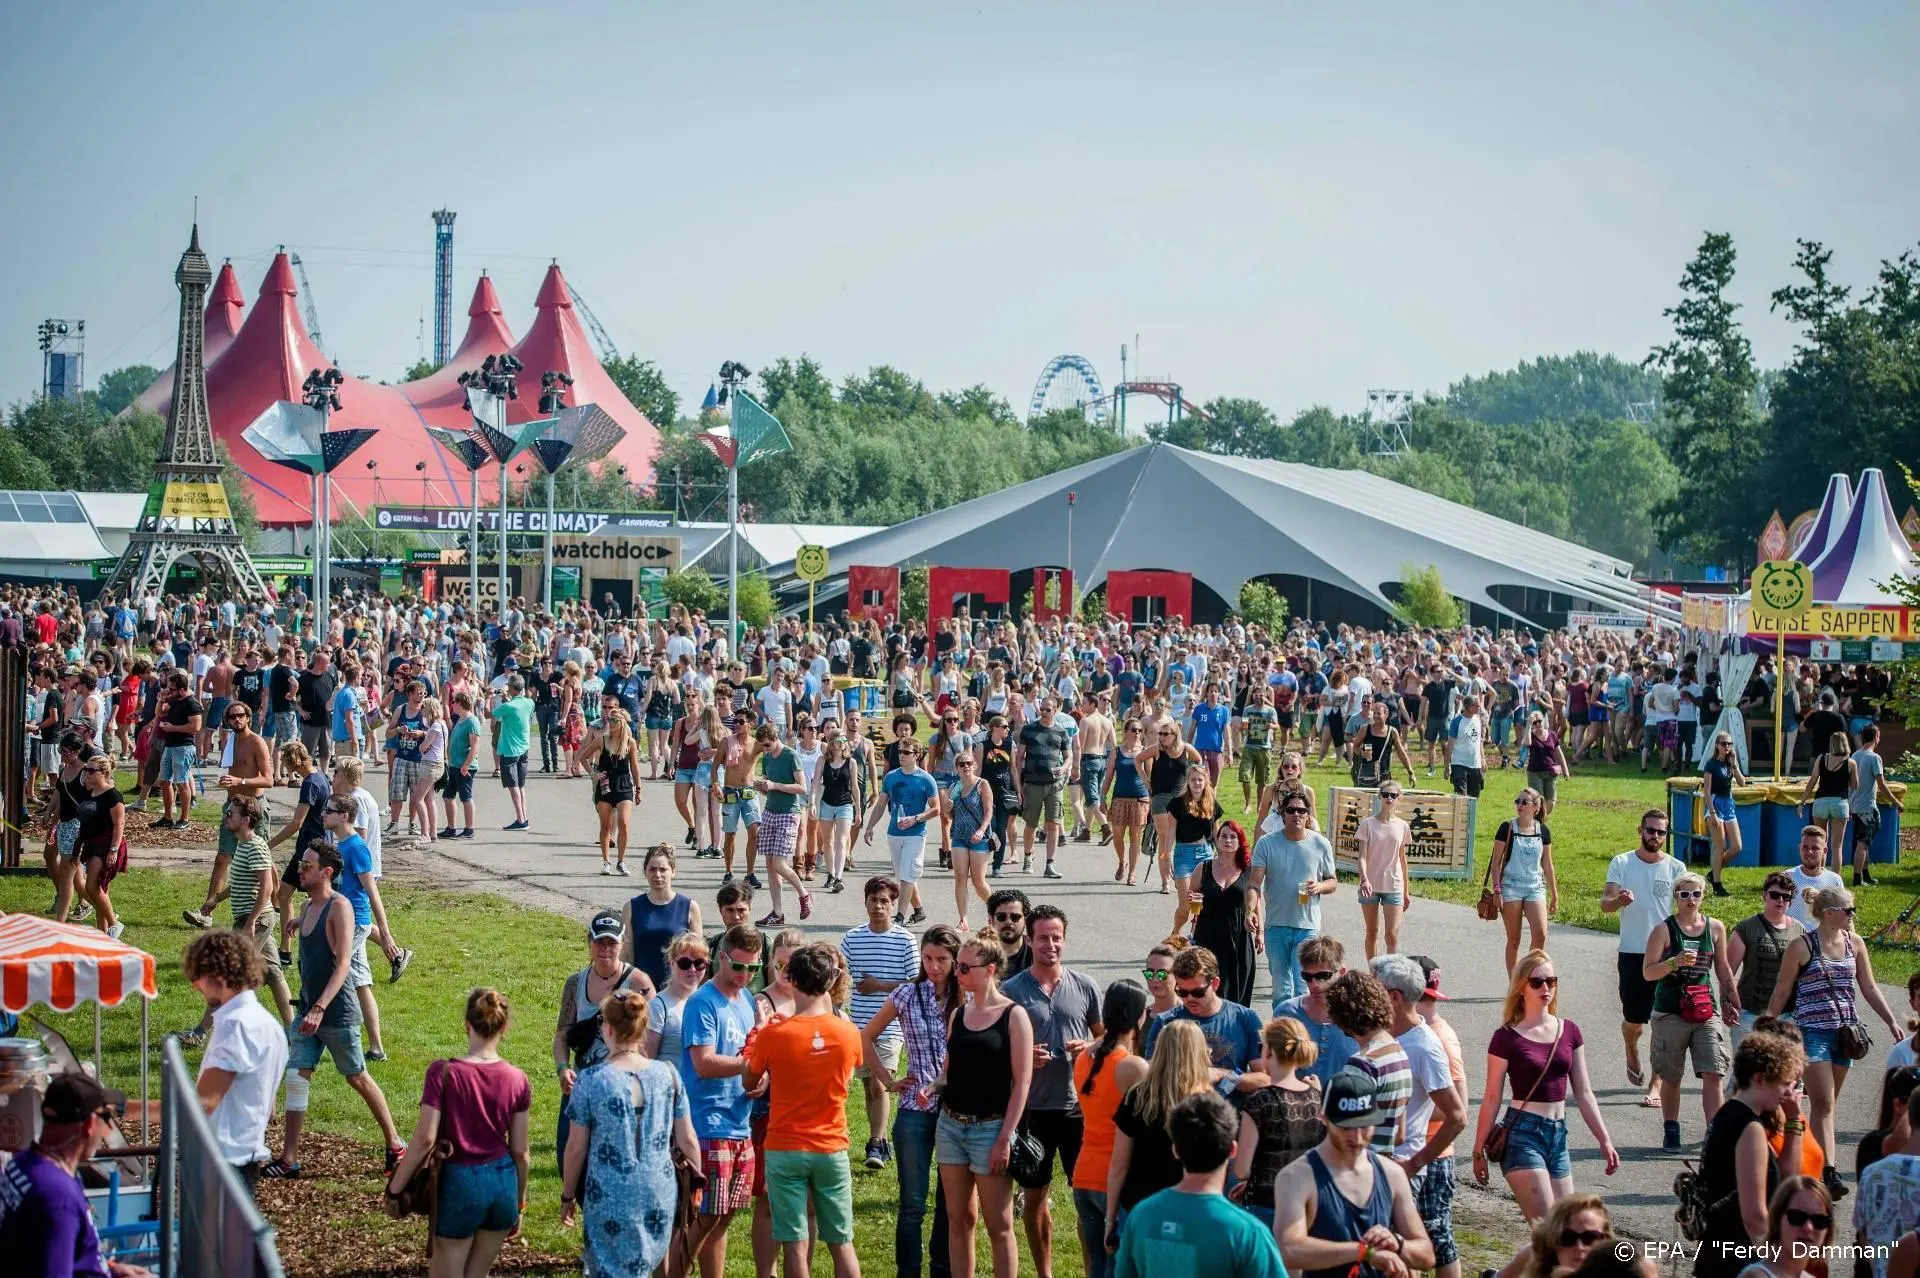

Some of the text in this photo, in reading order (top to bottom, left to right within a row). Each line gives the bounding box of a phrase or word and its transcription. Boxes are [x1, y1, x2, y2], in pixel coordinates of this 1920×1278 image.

[196, 497, 225, 505] CHANGE
[529, 512, 608, 531] CLIMATE
[552, 541, 656, 560] watchdoc
[1821, 611, 1895, 633] SAPPEN
[1200, 714, 1208, 722] 75
